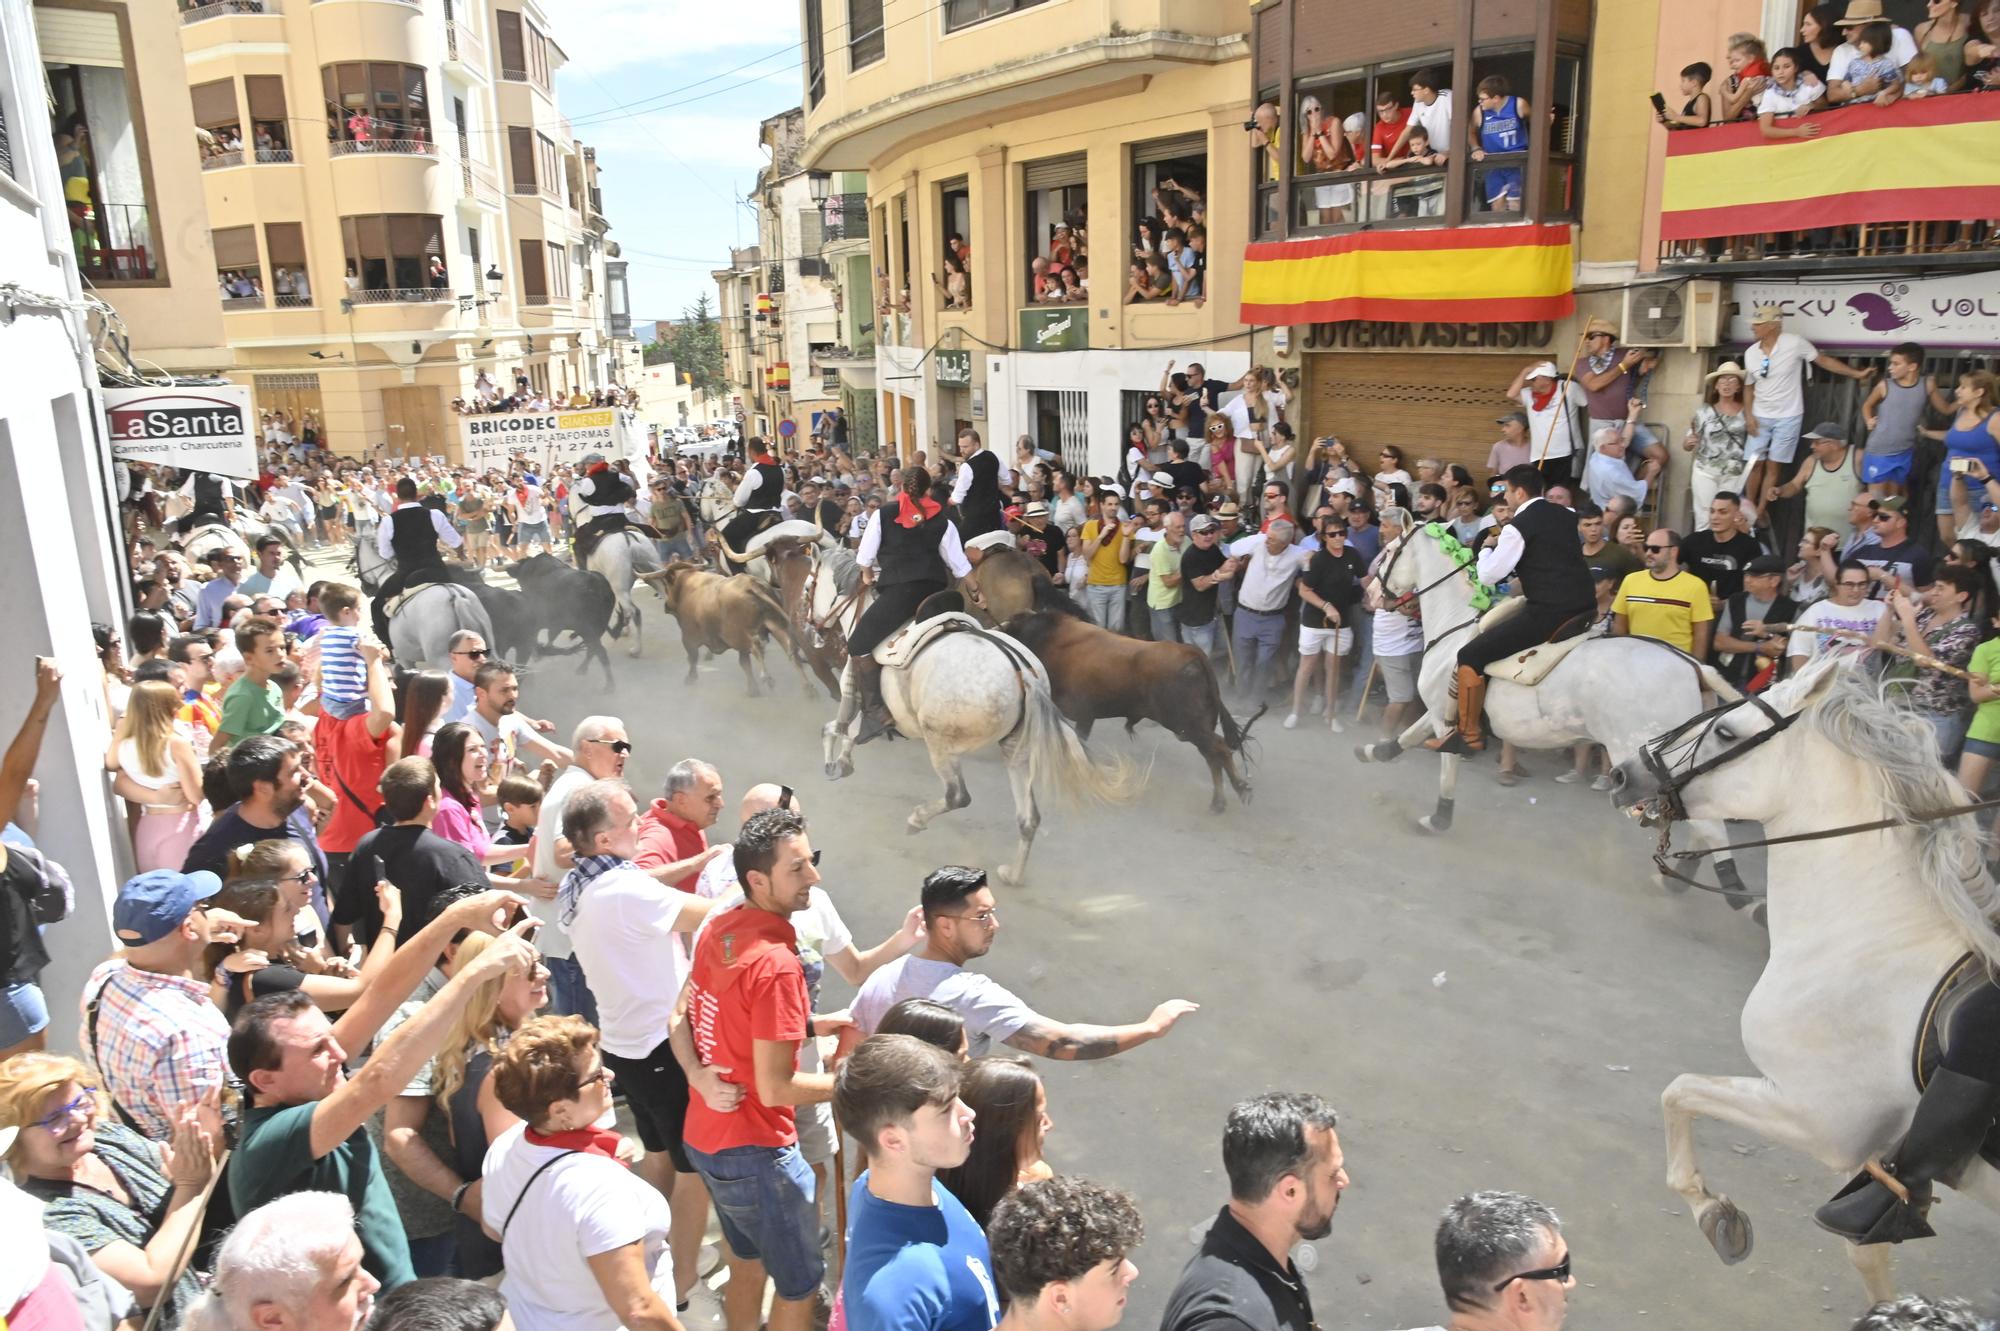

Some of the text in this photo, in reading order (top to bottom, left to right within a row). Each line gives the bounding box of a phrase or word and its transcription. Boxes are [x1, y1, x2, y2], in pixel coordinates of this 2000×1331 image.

[1499, 130, 1517, 148] 77
[1417, 321, 1553, 348] ASENSIO
[107, 411, 242, 438] LaSanta
[470, 416, 556, 435] BRICODEC
[470, 428, 611, 447] ALQUILER DE PLATAFORMAS
[569, 442, 587, 451] 27
[593, 440, 614, 449] 44
